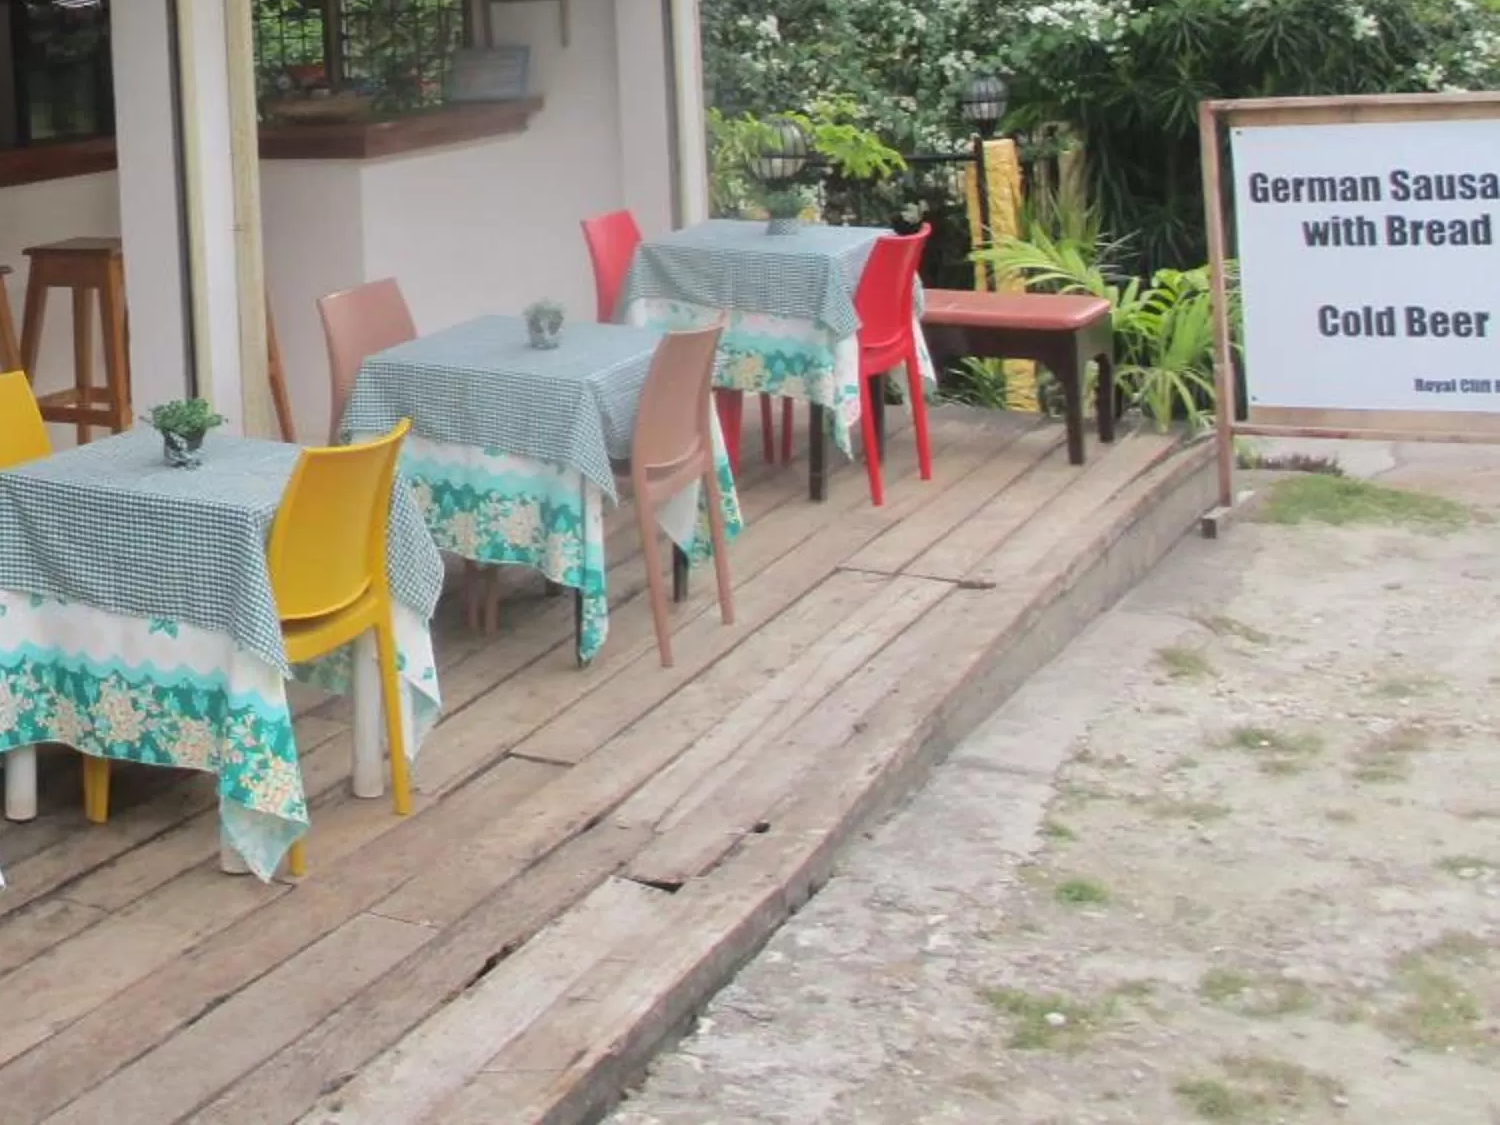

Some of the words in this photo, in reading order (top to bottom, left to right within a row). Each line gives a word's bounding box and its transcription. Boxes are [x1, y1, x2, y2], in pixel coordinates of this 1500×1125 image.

[1250, 173, 1381, 202] German
[1302, 216, 1376, 246] with
[1386, 214, 1492, 246] Bread
[1318, 305, 1396, 336] Cold
[1405, 307, 1489, 337] Beer
